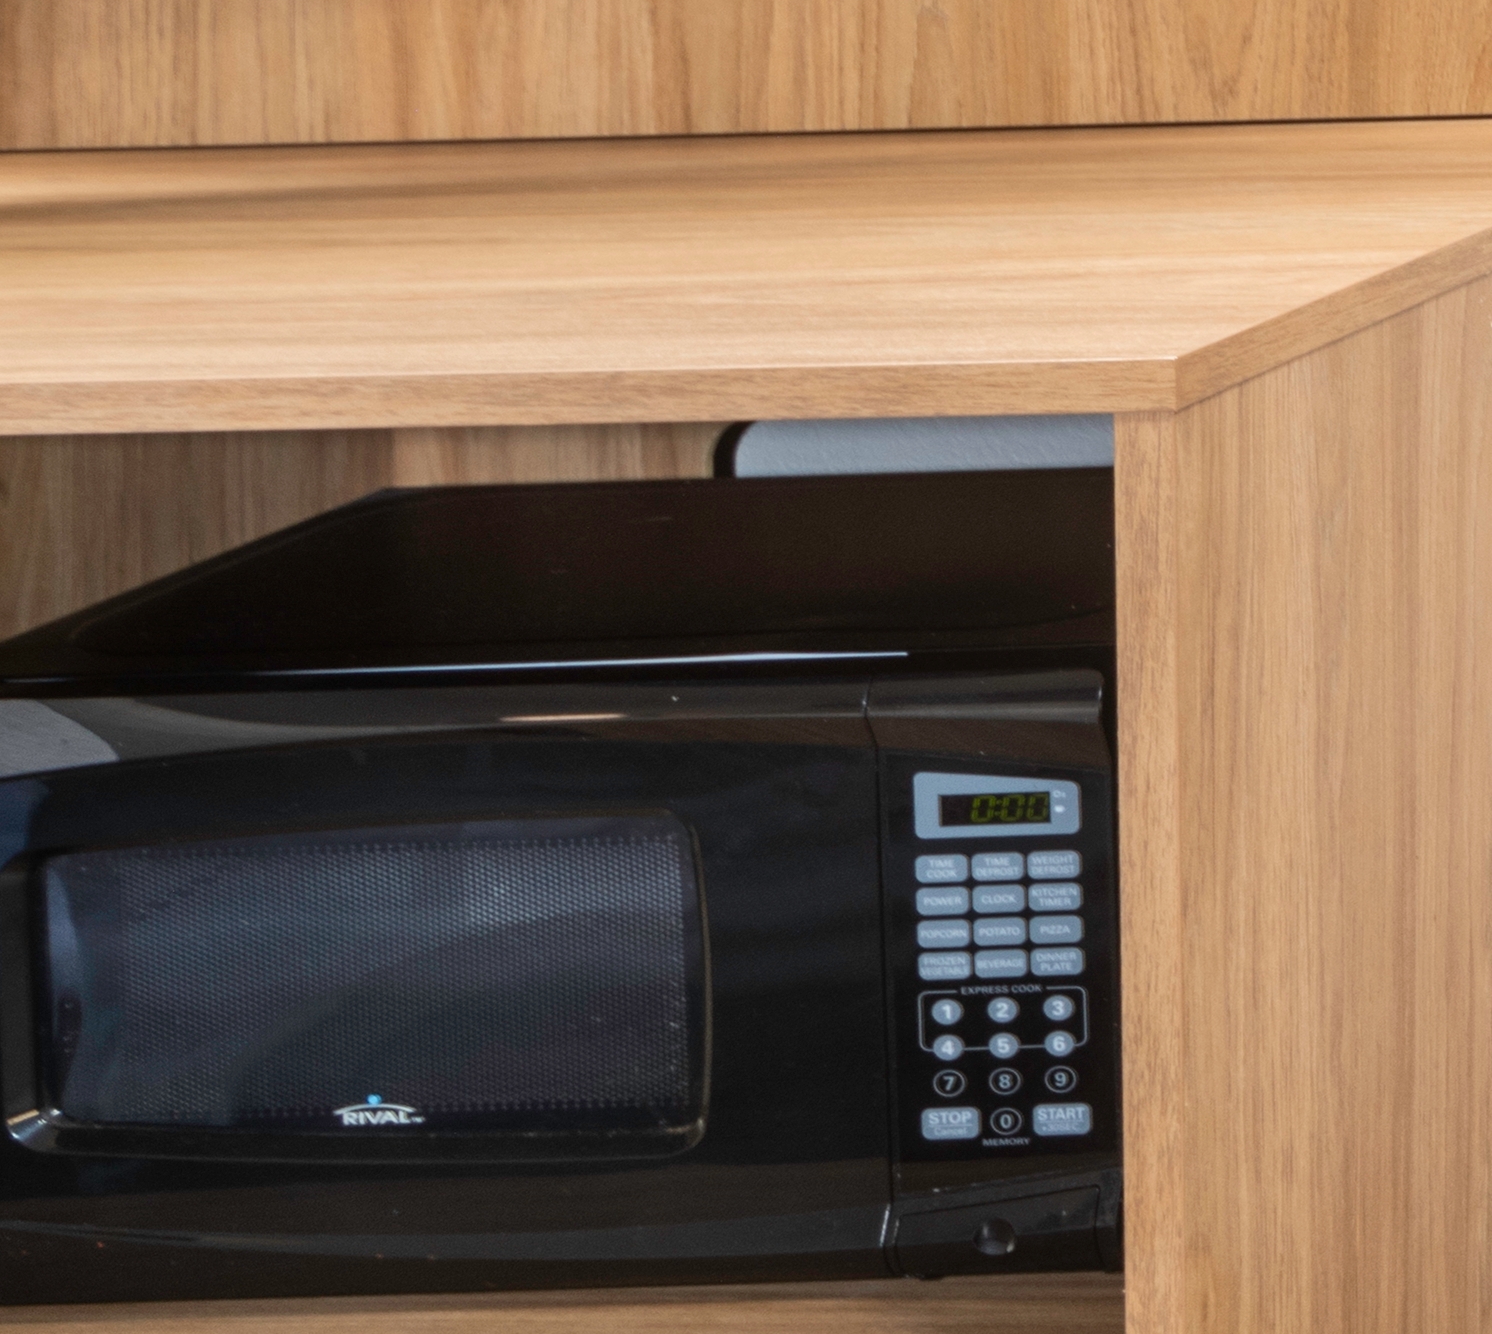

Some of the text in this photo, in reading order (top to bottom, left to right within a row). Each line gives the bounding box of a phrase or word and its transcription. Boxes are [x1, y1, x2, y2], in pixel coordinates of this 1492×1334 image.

[928, 859, 954, 868] TIME
[985, 857, 1010, 866] TIME
[1032, 854, 1073, 864] WEIGHT
[926, 869, 957, 878] COOK
[1031, 865, 1075, 874] DEFROST
[1032, 888, 1077, 897] KITCHEN
[923, 896, 962, 906] POWER
[981, 894, 1017, 904] CLOCK
[1039, 897, 1072, 906] TIMER
[920, 929, 967, 938] POPCORN
[979, 927, 1020, 936] POTATO
[1040, 925, 1070, 934] PIZZA
[924, 957, 965, 966] FROZEN
[1036, 952, 1077, 961] DINNER
[976, 958, 1024, 969] BEVERAGE
[1040, 962, 1073, 971] PLATE
[960, 984, 1043, 995] EXPRESS COOK
[941, 1005, 951, 1019] 1
[996, 1002, 1008, 1018] 2
[1052, 1000, 1064, 1016] 3
[941, 1040, 954, 1056] 4
[998, 1038, 1010, 1053] 5
[1053, 1036, 1065, 1051] 6
[943, 1076, 956, 1091] 7
[998, 1074, 1011, 1089] 8
[1054, 1072, 1067, 1087] 9
[342, 1110, 411, 1125] RIVAL
[929, 1112, 972, 1124] STOP
[1038, 1108, 1085, 1120] START
[1000, 1114, 1012, 1129] 0
[982, 1138, 1030, 1147] MEMORY
